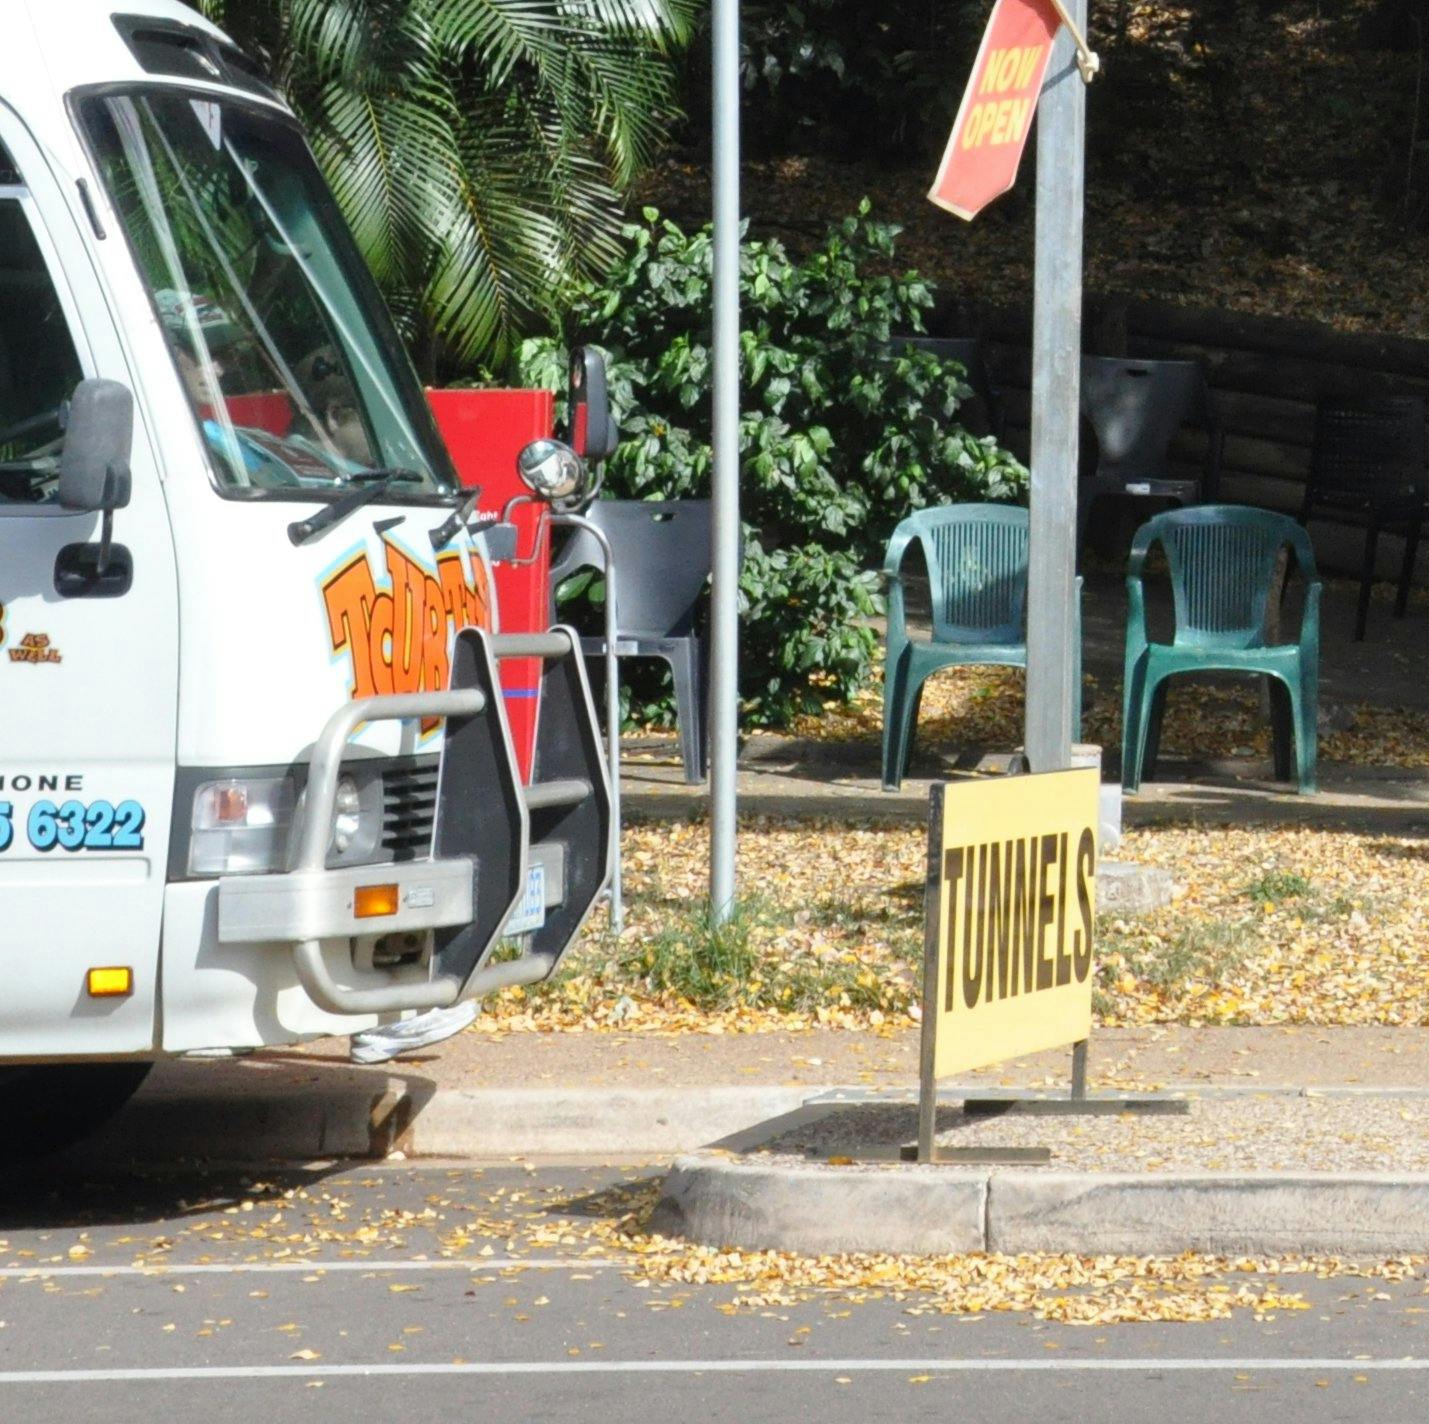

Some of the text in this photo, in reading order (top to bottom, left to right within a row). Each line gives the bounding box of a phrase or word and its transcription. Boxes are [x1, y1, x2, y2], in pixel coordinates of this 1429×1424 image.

[978, 44, 1045, 95] NOW
[962, 97, 1032, 151] OPEN
[20, 633, 50, 648] AS
[0, 775, 83, 792] ONE
[27, 799, 146, 852] 6322
[944, 826, 1095, 1013] TUNNELS
